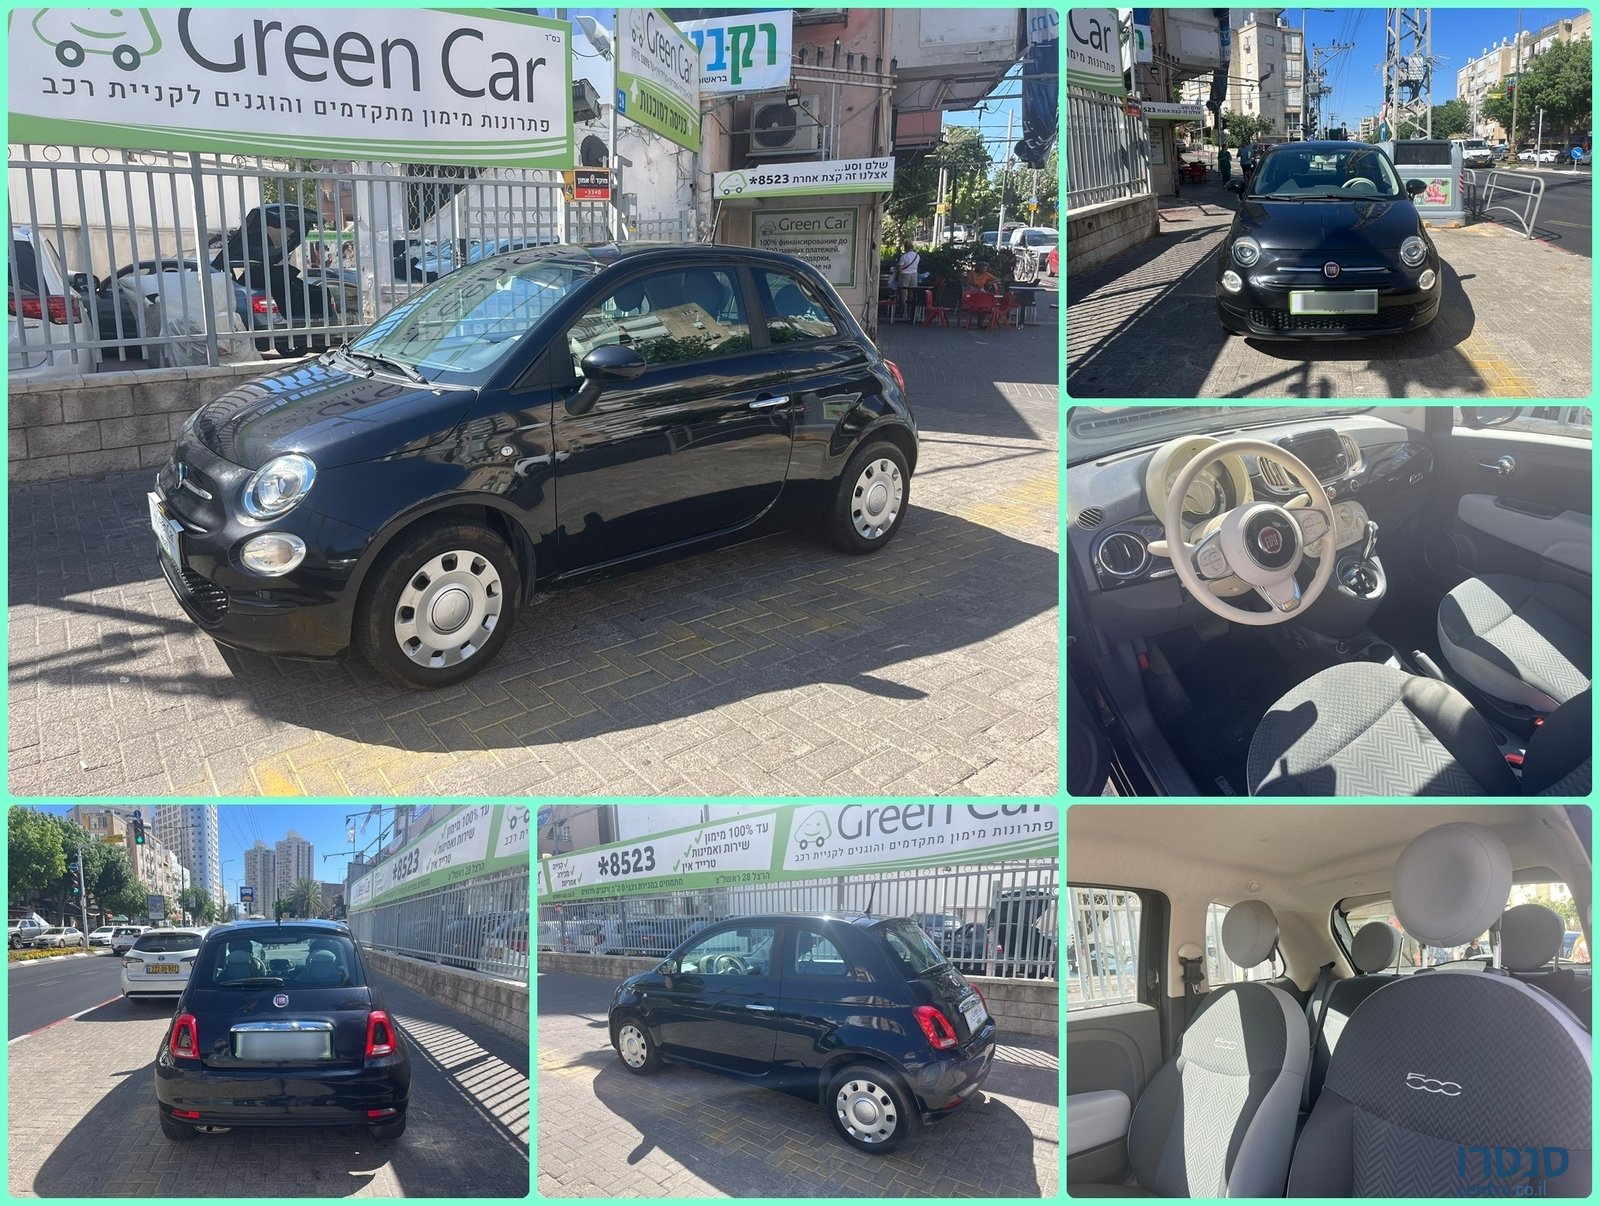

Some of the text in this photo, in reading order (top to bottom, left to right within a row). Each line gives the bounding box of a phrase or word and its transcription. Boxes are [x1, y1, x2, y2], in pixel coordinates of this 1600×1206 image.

[1069, 9, 1111, 53] Car
[178, 8, 420, 92] Green
[441, 28, 546, 103] Car
[647, 12, 676, 73] Green
[678, 44, 693, 85] Car
[1067, 48, 1115, 72] פתרונות מימו
[42, 77, 550, 132] פתרונות מימון מתקדמים והוגנים לקניית רכב
[640, 89, 687, 135] כניסה לסוכנות
[859, 171, 887, 180] אצלנו
[865, 162, 888, 170] שלם
[792, 176, 818, 184] אחרת
[822, 175, 842, 183] קצת
[779, 217, 849, 231] Green Car
[838, 804, 952, 840] Green
[504, 834, 517, 846] רכב
[705, 823, 768, 845] עד 100% מימון
[795, 821, 1053, 862] פתרונות מימון מתקדמים והוגנים לקניית רכב
[692, 840, 750, 857] שירות ואמינות
[682, 859, 716, 874] טרייד אין
[752, 872, 770, 880] הרצל
[1214, 1038, 1238, 1050] 500
[1406, 1072, 1462, 1096] 500
